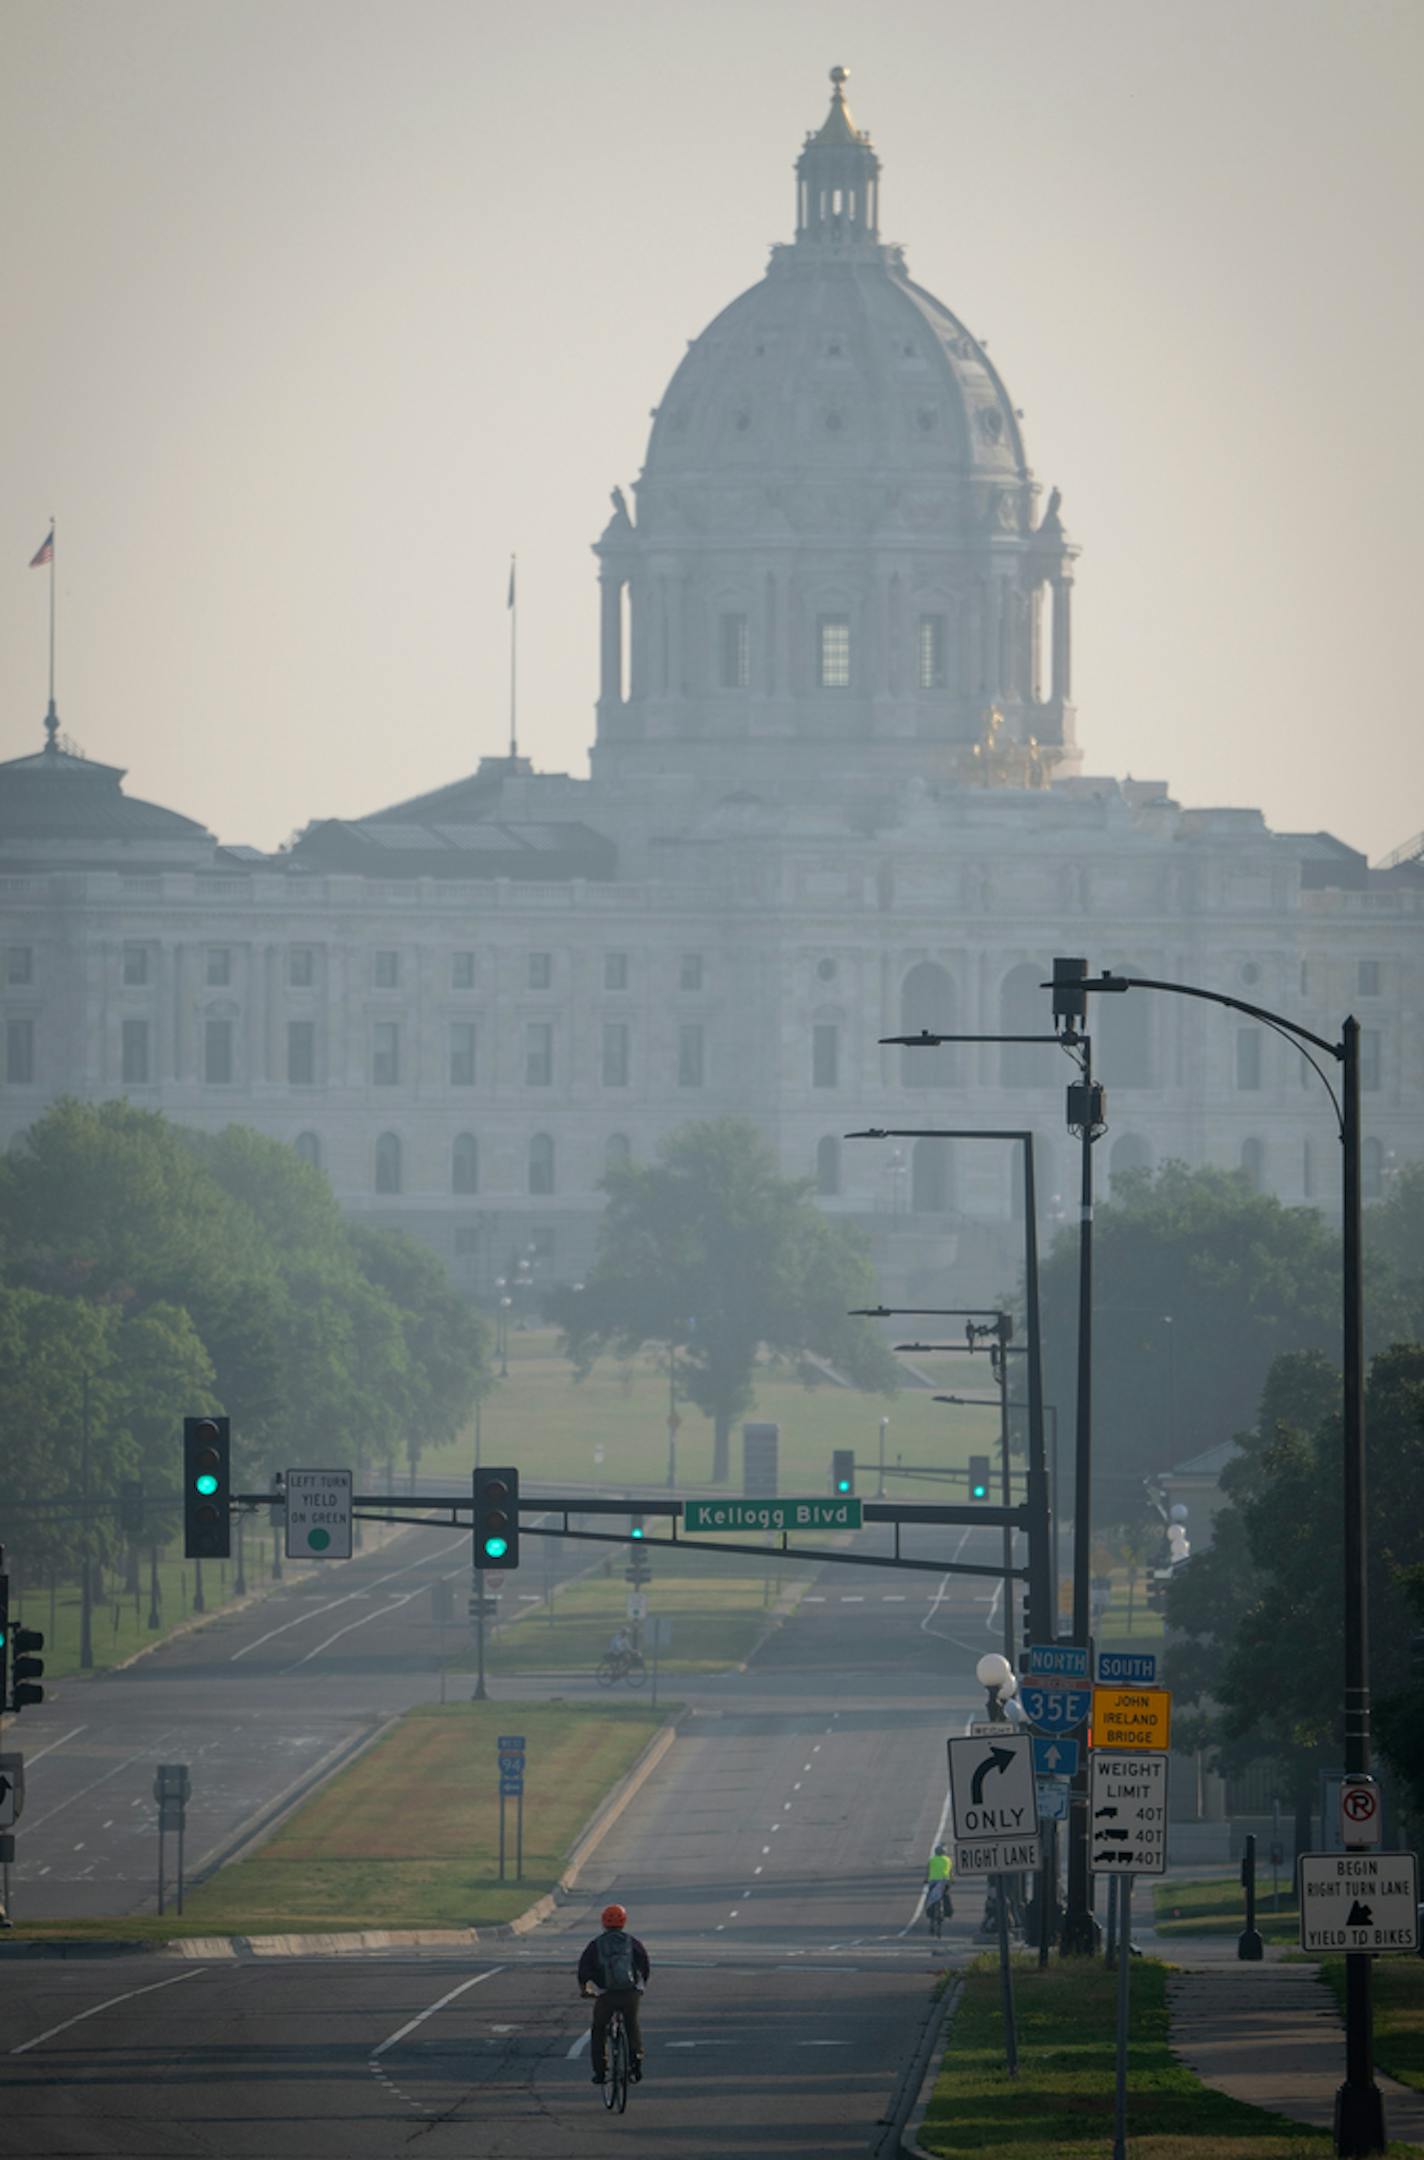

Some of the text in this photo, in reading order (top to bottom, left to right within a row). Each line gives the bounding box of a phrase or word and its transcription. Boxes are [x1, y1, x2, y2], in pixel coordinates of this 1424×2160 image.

[291, 1475, 347, 1488] LEFT TURN
[301, 1494, 338, 1507] YIELD
[290, 1511, 347, 1524] ON GREEN
[699, 1505, 848, 1528] Kellogg Blvd
[1032, 1651, 1086, 1671] NORTH
[1100, 1659, 1153, 1677] SOUTH
[1030, 1693, 1081, 1722] 35E
[1114, 1696, 1150, 1708] JOHN
[1104, 1713, 1158, 1726] IRELAND
[1107, 1731, 1153, 1743] BRIDGE
[502, 1758, 521, 1772] 94
[1098, 1762, 1162, 1777] WEIGHT
[1107, 1785, 1151, 1798] LIMIT
[965, 1808, 1025, 1830] ONLY
[1136, 1808, 1163, 1821] 40T
[1135, 1830, 1163, 1842] 40T
[961, 1845, 1036, 1868] RIGHT LANE
[1134, 1852, 1162, 1865] 40T
[1337, 1860, 1378, 1876] BEGIN
[1307, 1880, 1410, 1897] RIGHT TURN LANE
[1308, 1929, 1412, 1945] YIELD TO BIKES
